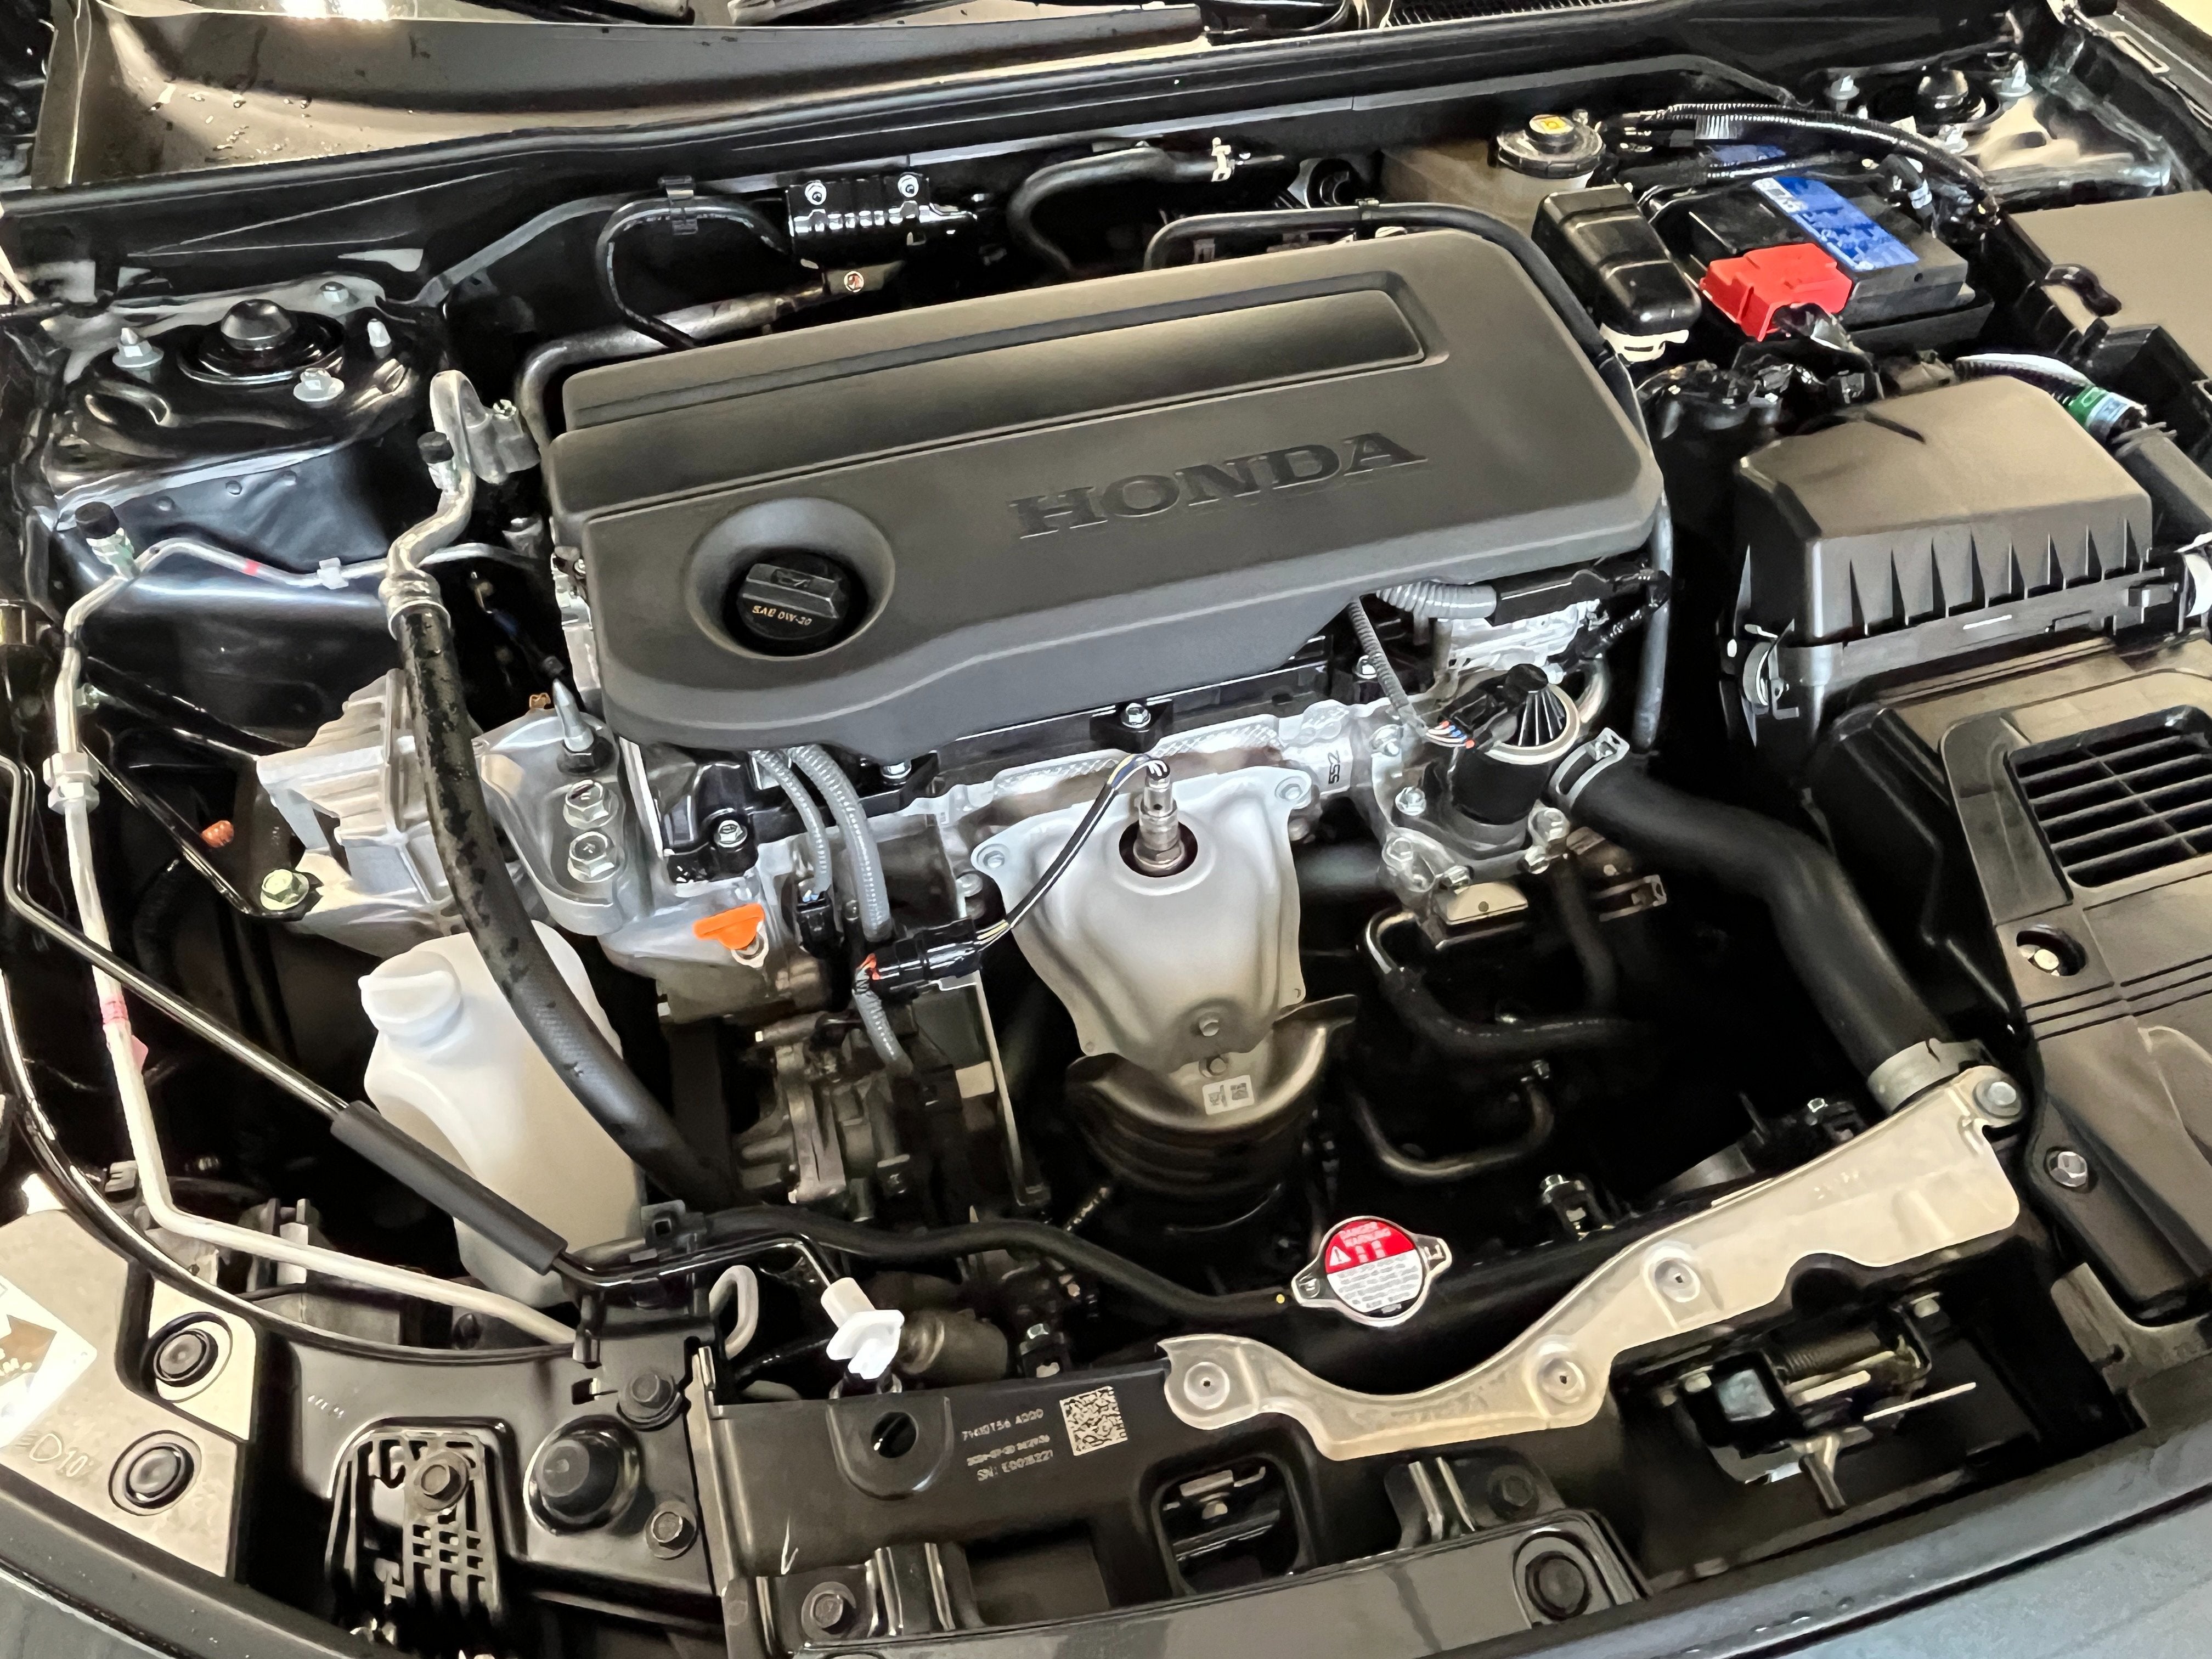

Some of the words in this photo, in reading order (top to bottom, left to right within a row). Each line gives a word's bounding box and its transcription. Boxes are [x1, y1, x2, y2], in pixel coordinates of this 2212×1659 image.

[1006, 432, 1428, 539] HONDA
[752, 605, 777, 617] SAE
[777, 611, 812, 626] 0W-20
[1328, 749, 1341, 785] 552
